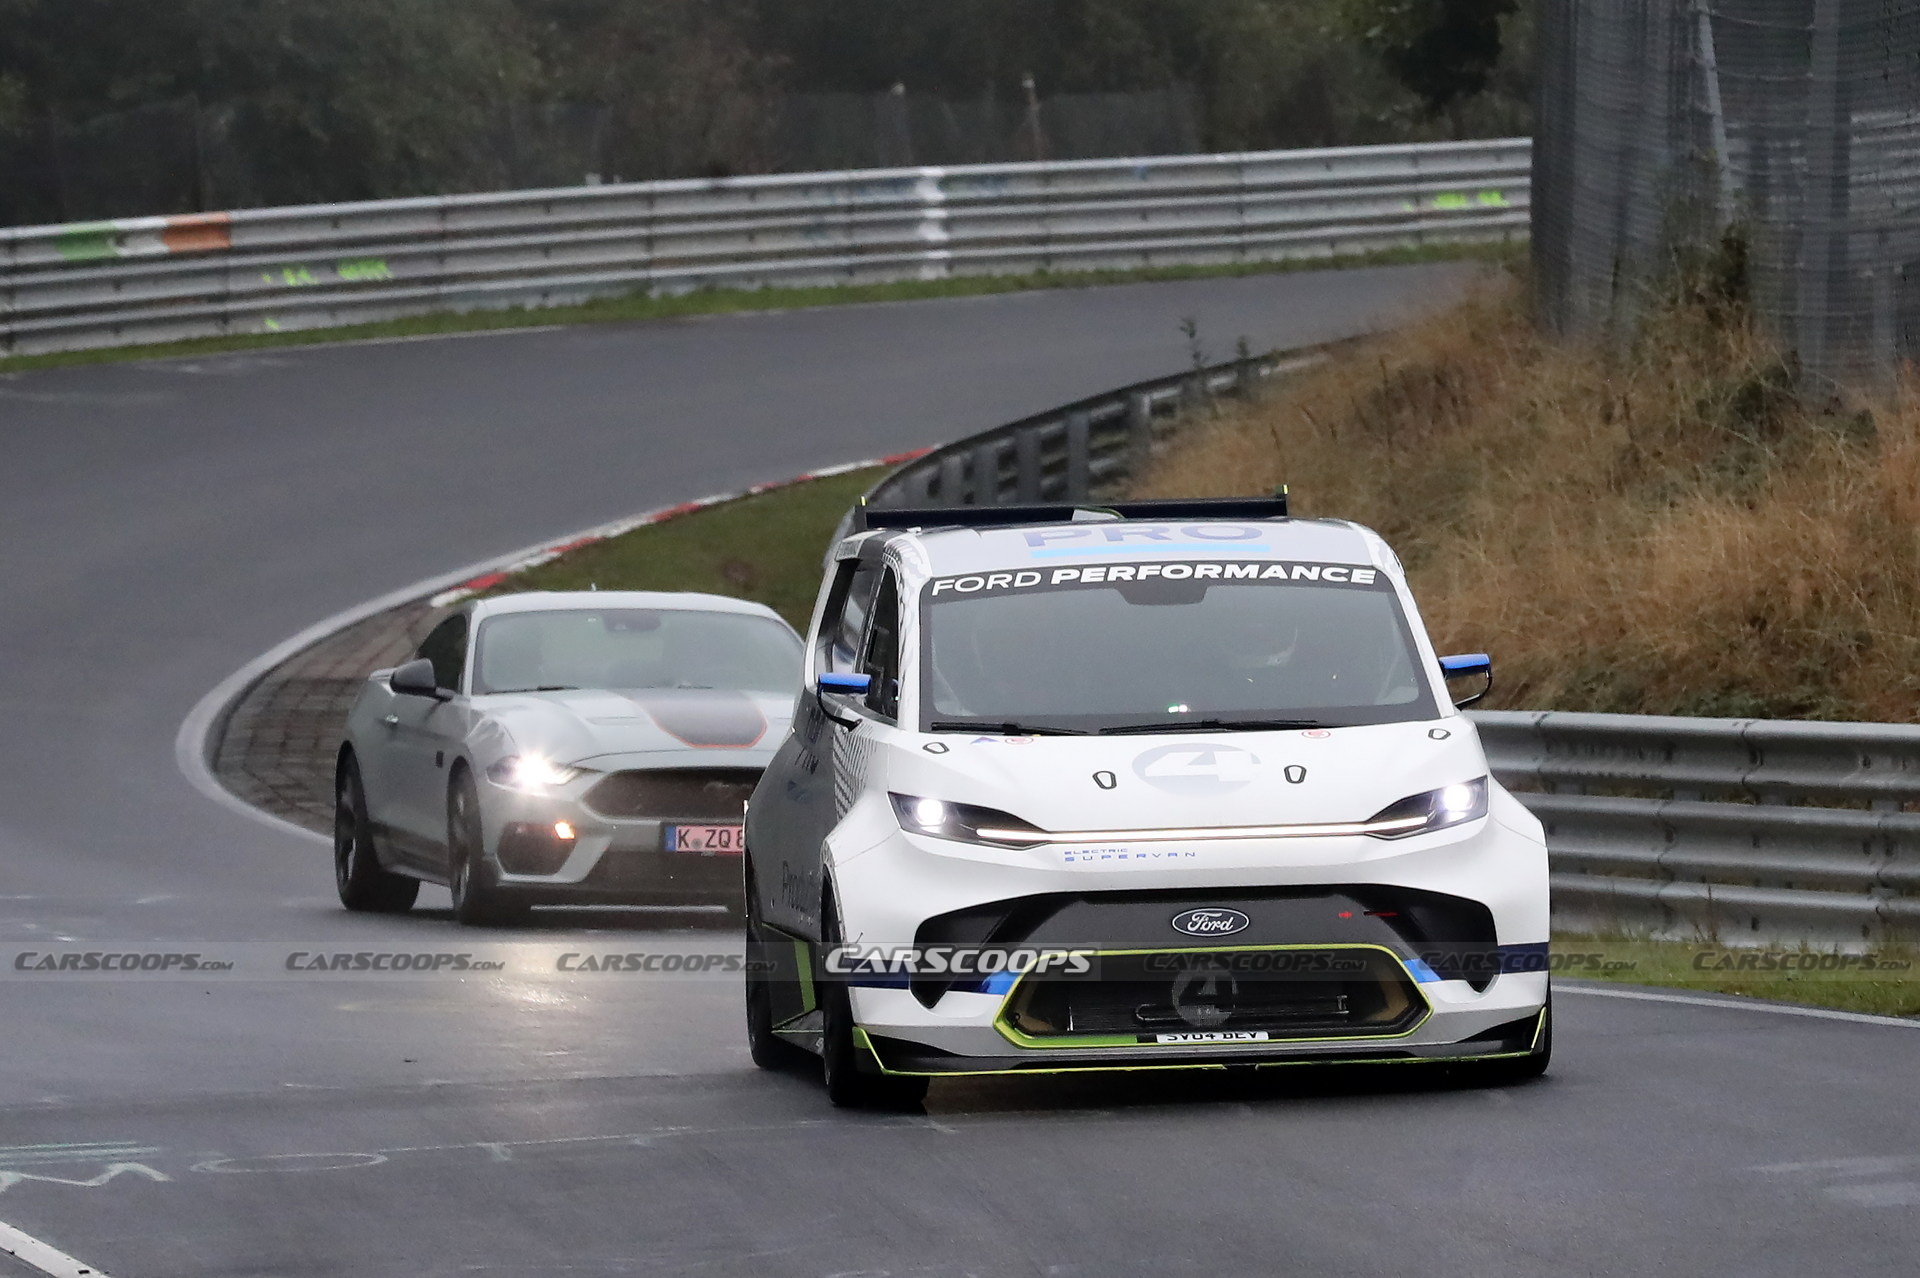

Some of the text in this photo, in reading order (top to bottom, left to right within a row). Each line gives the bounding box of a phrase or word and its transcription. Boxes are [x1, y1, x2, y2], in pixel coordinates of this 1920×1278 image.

[1022, 525, 1263, 547] PRO
[931, 564, 1377, 596] FORD PERFORMANCE
[678, 828, 690, 849] K
[1064, 848, 1128, 856] ELECTRIC
[1065, 852, 1196, 862] SUPERVAN
[1187, 912, 1234, 931] Ford
